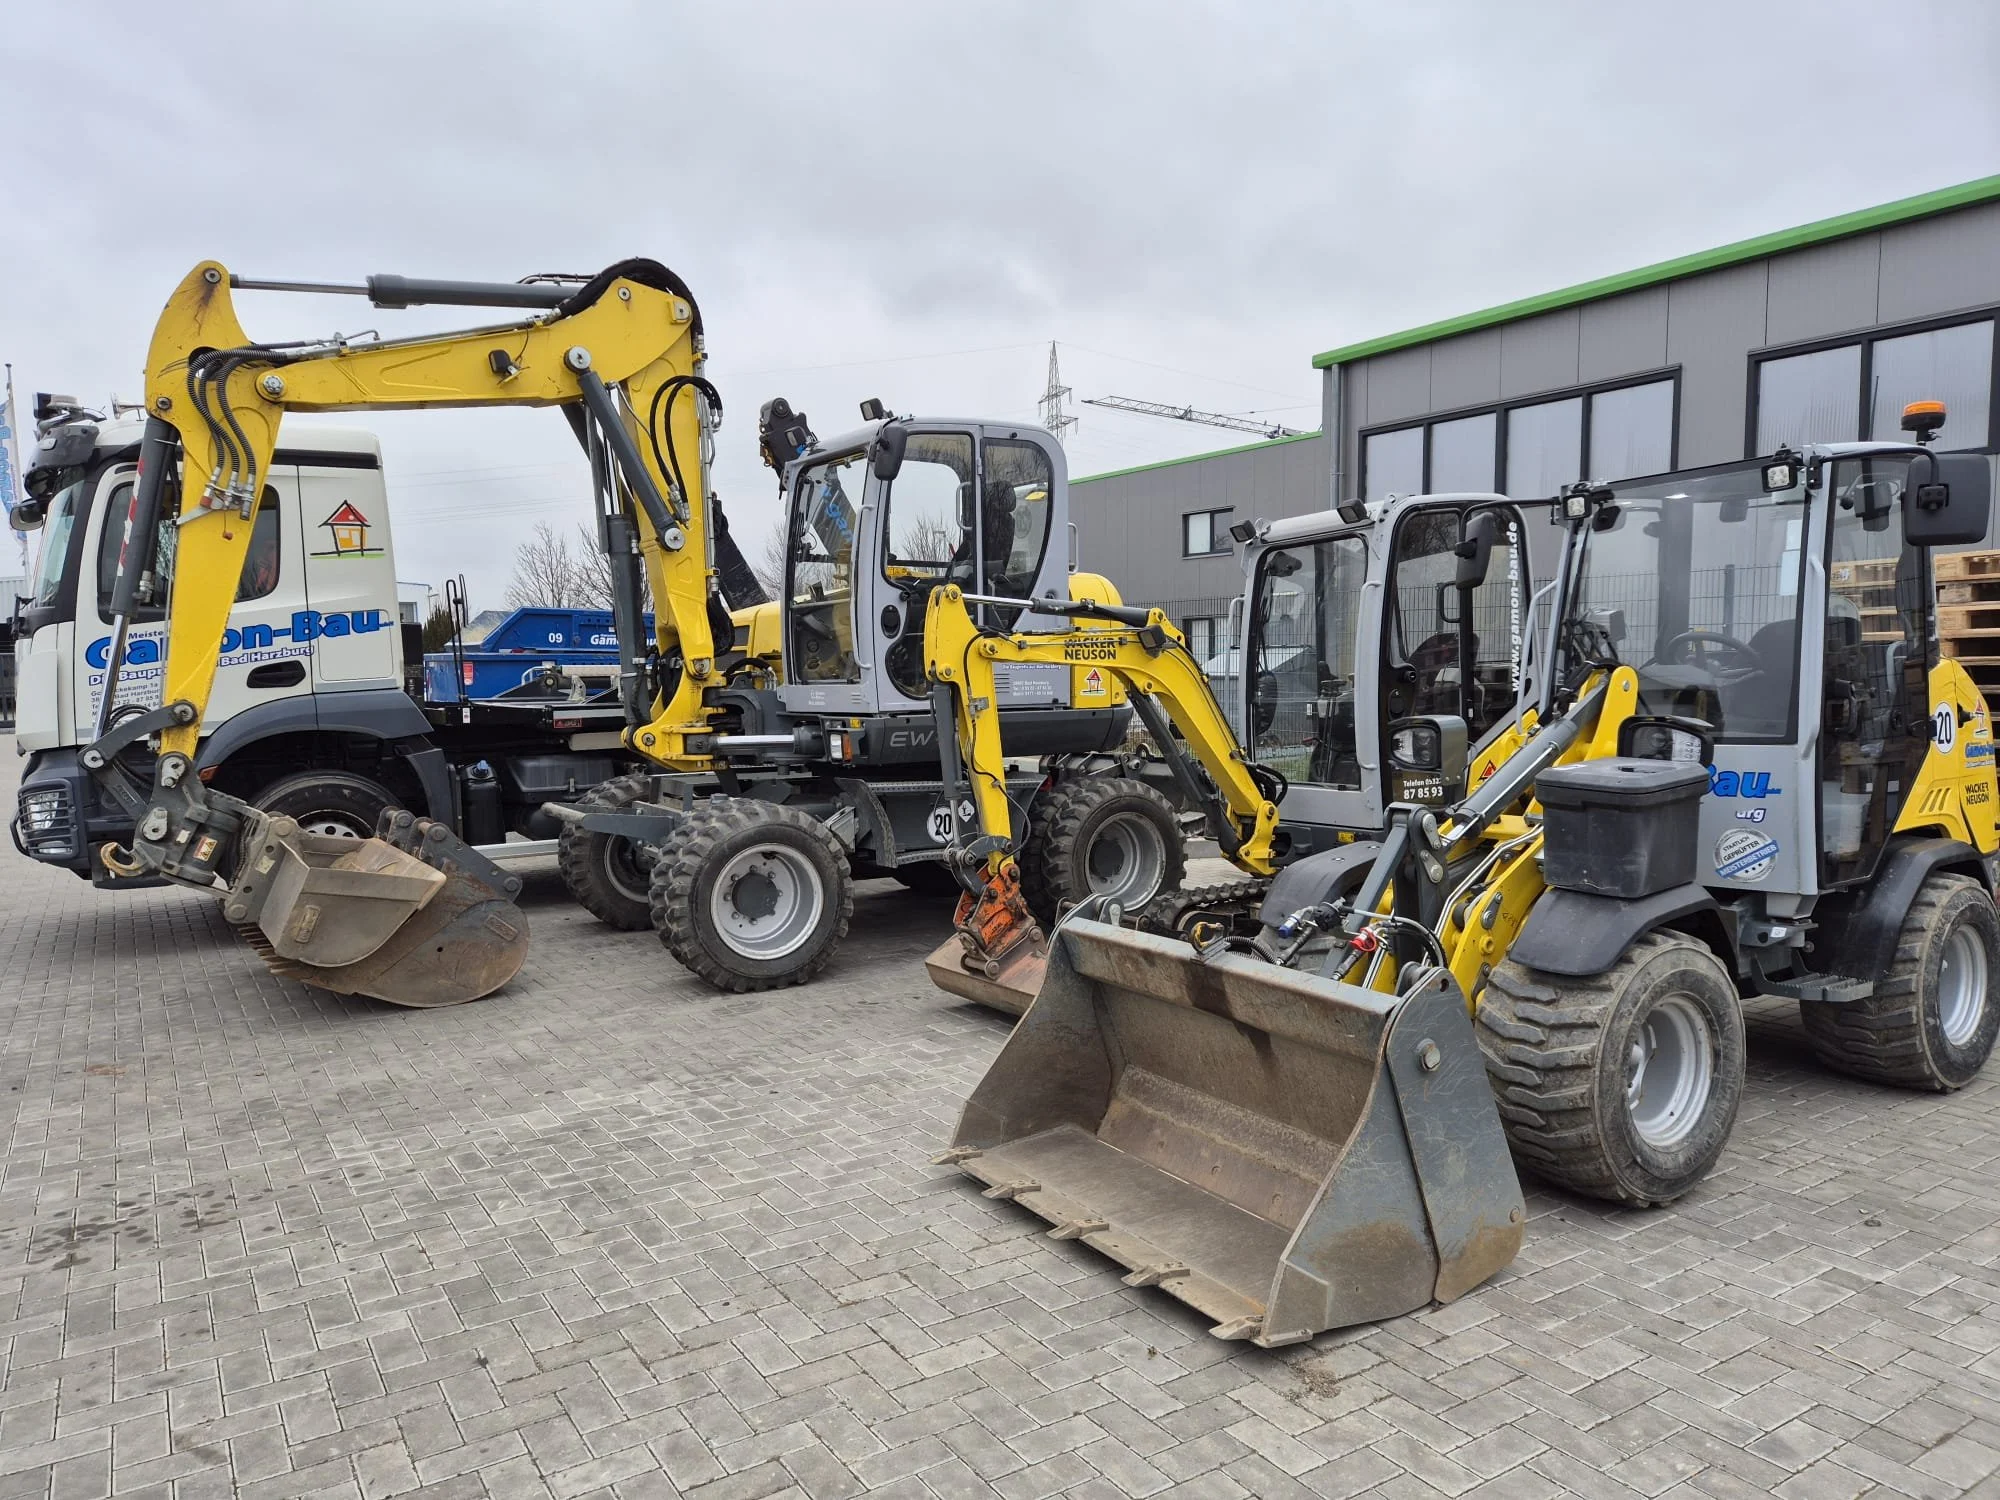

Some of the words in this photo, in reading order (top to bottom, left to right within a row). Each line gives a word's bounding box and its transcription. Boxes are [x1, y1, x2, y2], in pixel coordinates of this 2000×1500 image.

[1505, 521, 1521, 692] www.gamon-bau.de
[548, 633, 563, 643] 09
[1064, 637, 1116, 648] WACKER
[220, 653, 249, 667] Bad
[250, 645, 314, 662] Harzburg
[1064, 649, 1117, 660] NEUSON
[1938, 711, 1951, 744] 20
[1403, 789, 1416, 800] 87
[1417, 787, 1430, 799] 85
[1431, 786, 1443, 797] 93
[1965, 782, 1989, 794] WACKER
[1966, 793, 1990, 806] NEUSON
[935, 813, 952, 836] 20
[1723, 836, 1750, 852] STAATLICH
[1723, 840, 1760, 862] GEPRÜFTER
[1718, 844, 1777, 876] MEISTERBETRIEB
